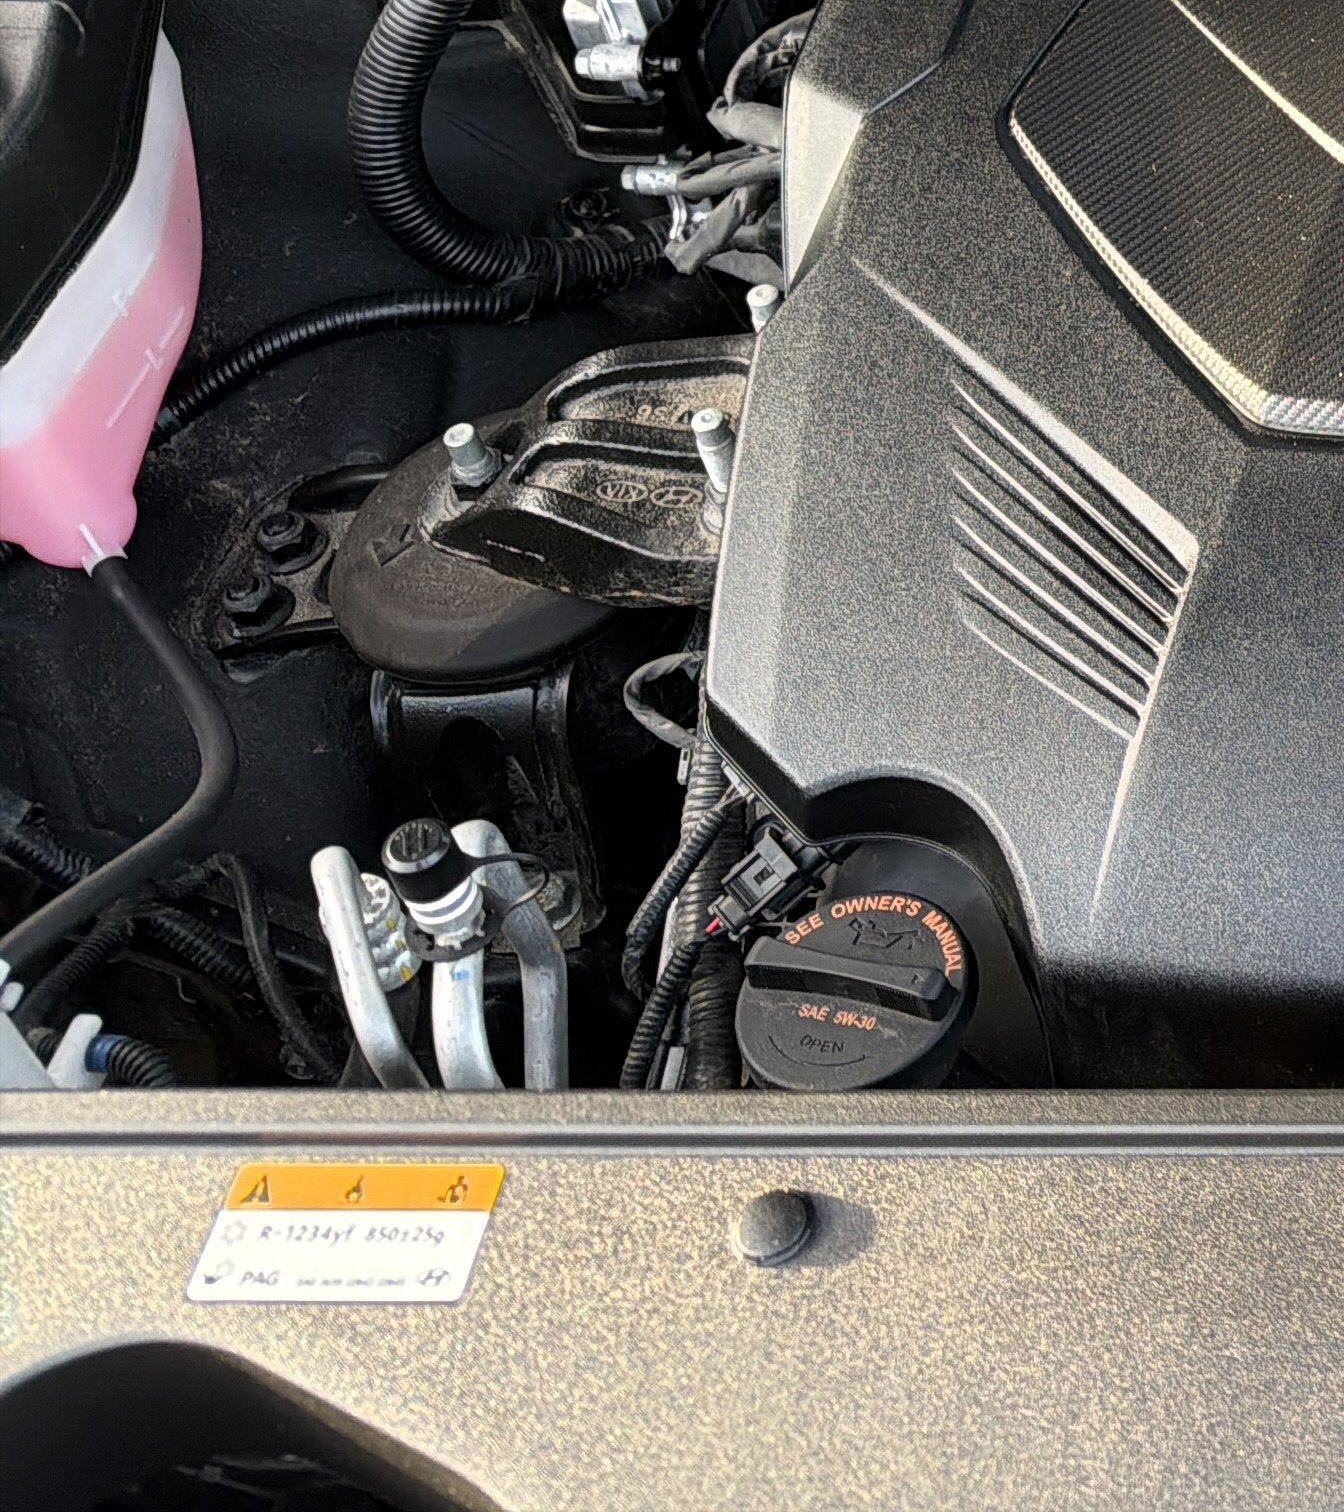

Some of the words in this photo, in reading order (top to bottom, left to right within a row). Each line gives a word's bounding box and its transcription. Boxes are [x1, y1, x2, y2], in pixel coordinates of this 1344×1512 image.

[784, 912, 824, 946] SEE
[831, 894, 922, 920] OWNER'S
[921, 909, 962, 978] MANUAL
[798, 1002, 831, 1022] SAE
[832, 1011, 878, 1032] 5W-30
[800, 1034, 845, 1054] OPEN
